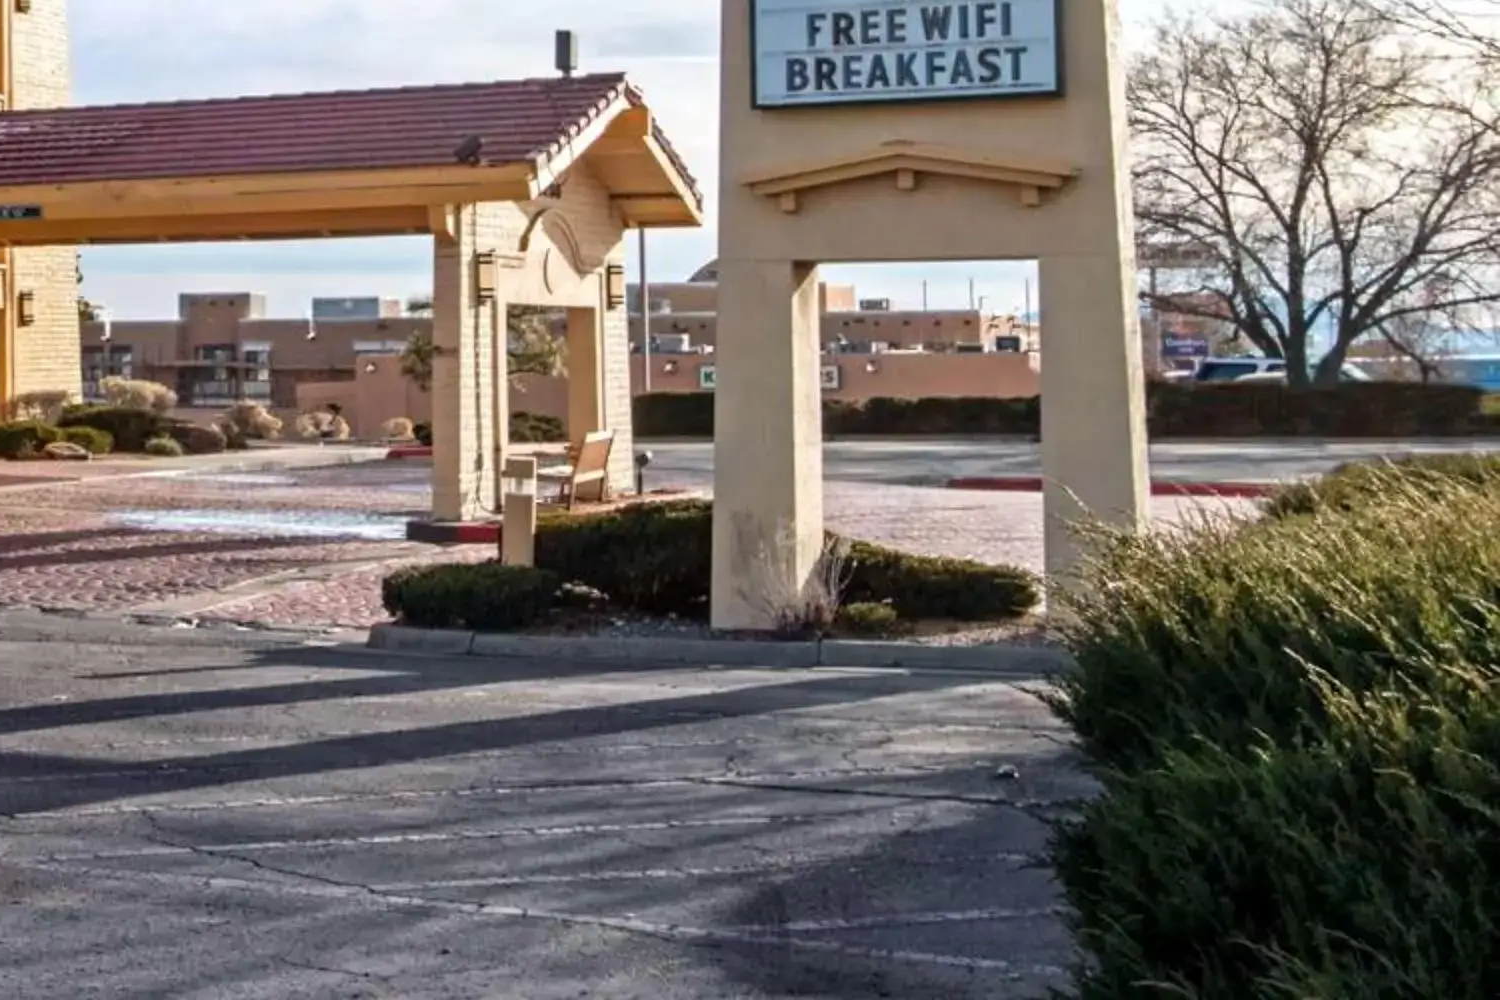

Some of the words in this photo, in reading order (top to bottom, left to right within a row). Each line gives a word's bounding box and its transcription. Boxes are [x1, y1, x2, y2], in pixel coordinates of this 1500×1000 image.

[805, 9, 907, 48] FREE
[920, 2, 1012, 42] WIFI
[785, 47, 1028, 92] BREAKFAST
